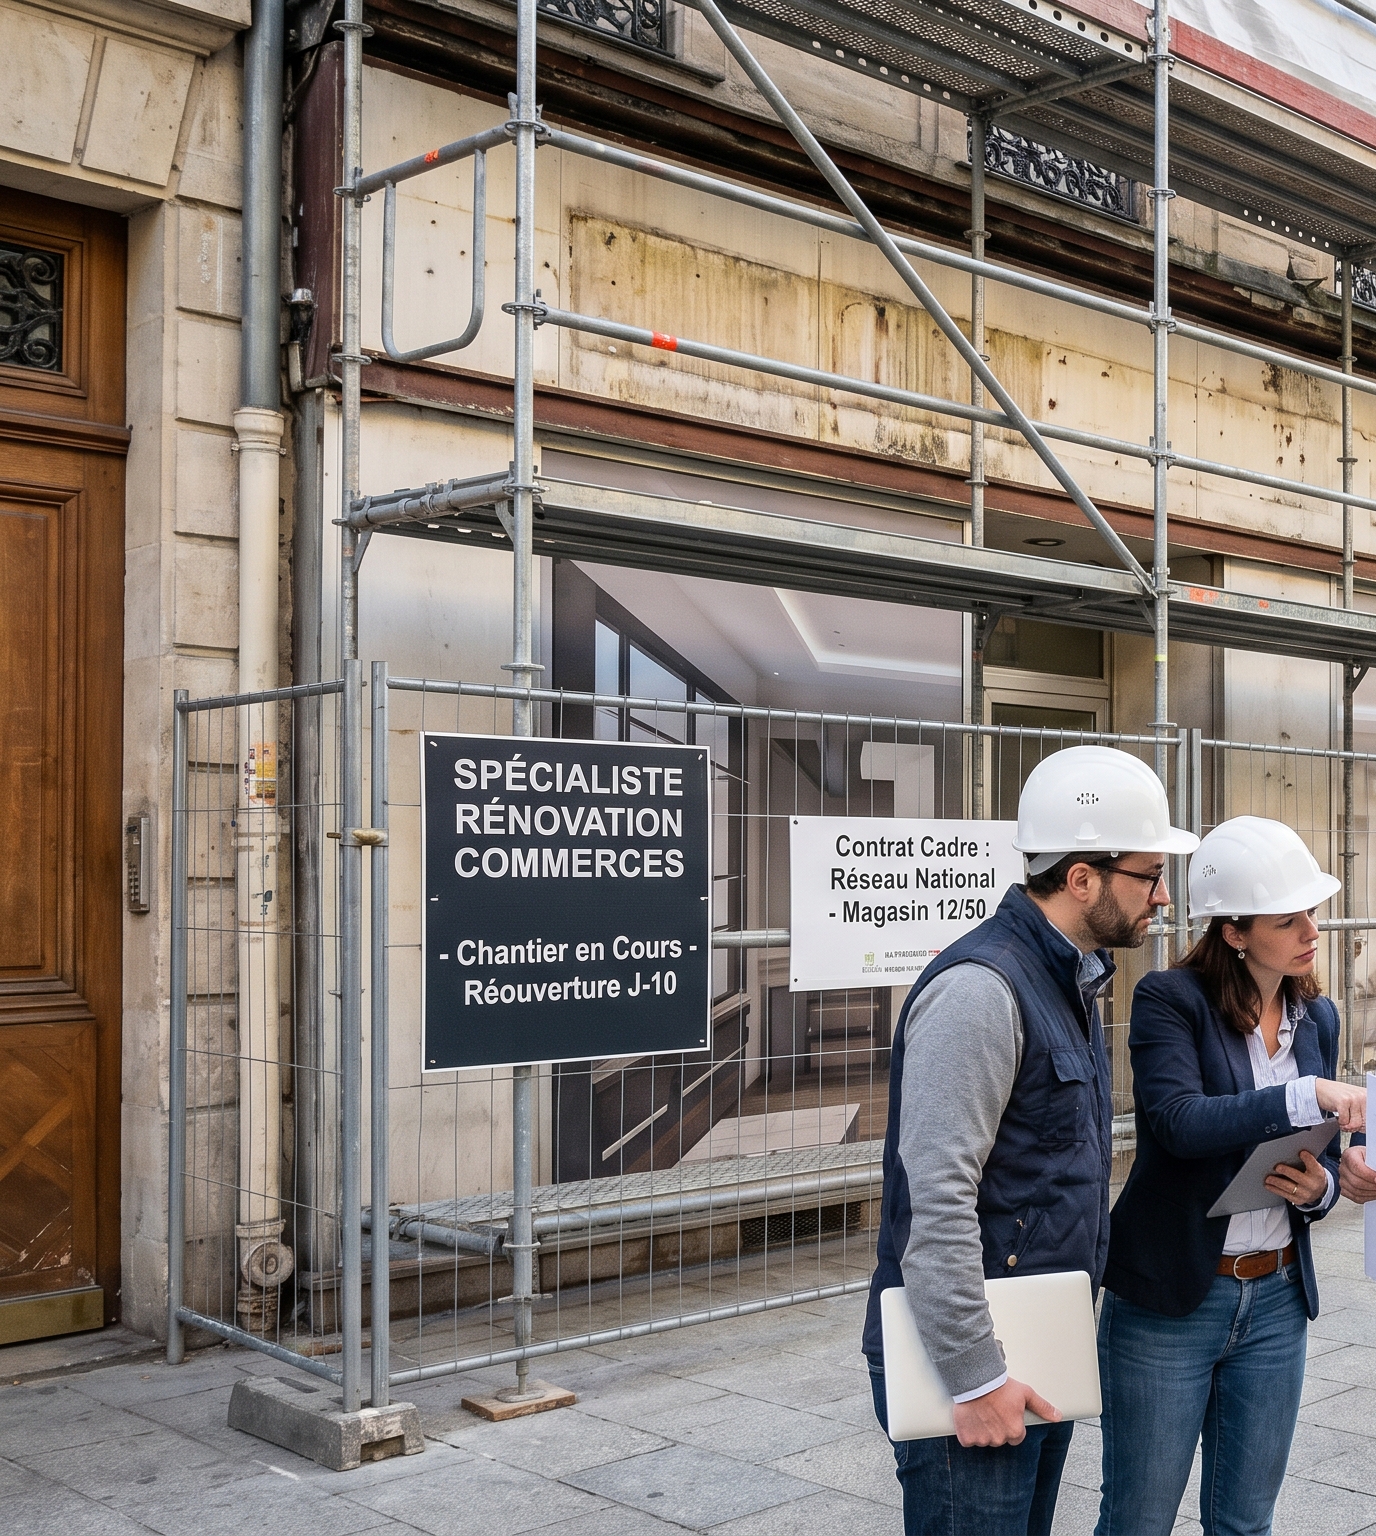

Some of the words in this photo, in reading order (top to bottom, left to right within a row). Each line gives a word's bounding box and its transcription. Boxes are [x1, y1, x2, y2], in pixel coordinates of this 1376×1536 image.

[453, 753, 684, 797] SPÉCIALISTE
[455, 796, 683, 838] RÉNOVATION
[835, 834, 914, 858] Contrat
[920, 835, 979, 858] Cadre
[984, 841, 990, 858] :
[454, 847, 685, 879] COMMERCES
[830, 867, 908, 890] Réseau
[915, 867, 996, 889] National
[842, 899, 929, 929] Magasin
[936, 898, 986, 920] 12/50
[456, 938, 569, 966] Chantier
[575, 942, 605, 962] en
[612, 935, 682, 961] Cours
[464, 976, 621, 1006] Réouverture
[627, 970, 677, 997] J-10
